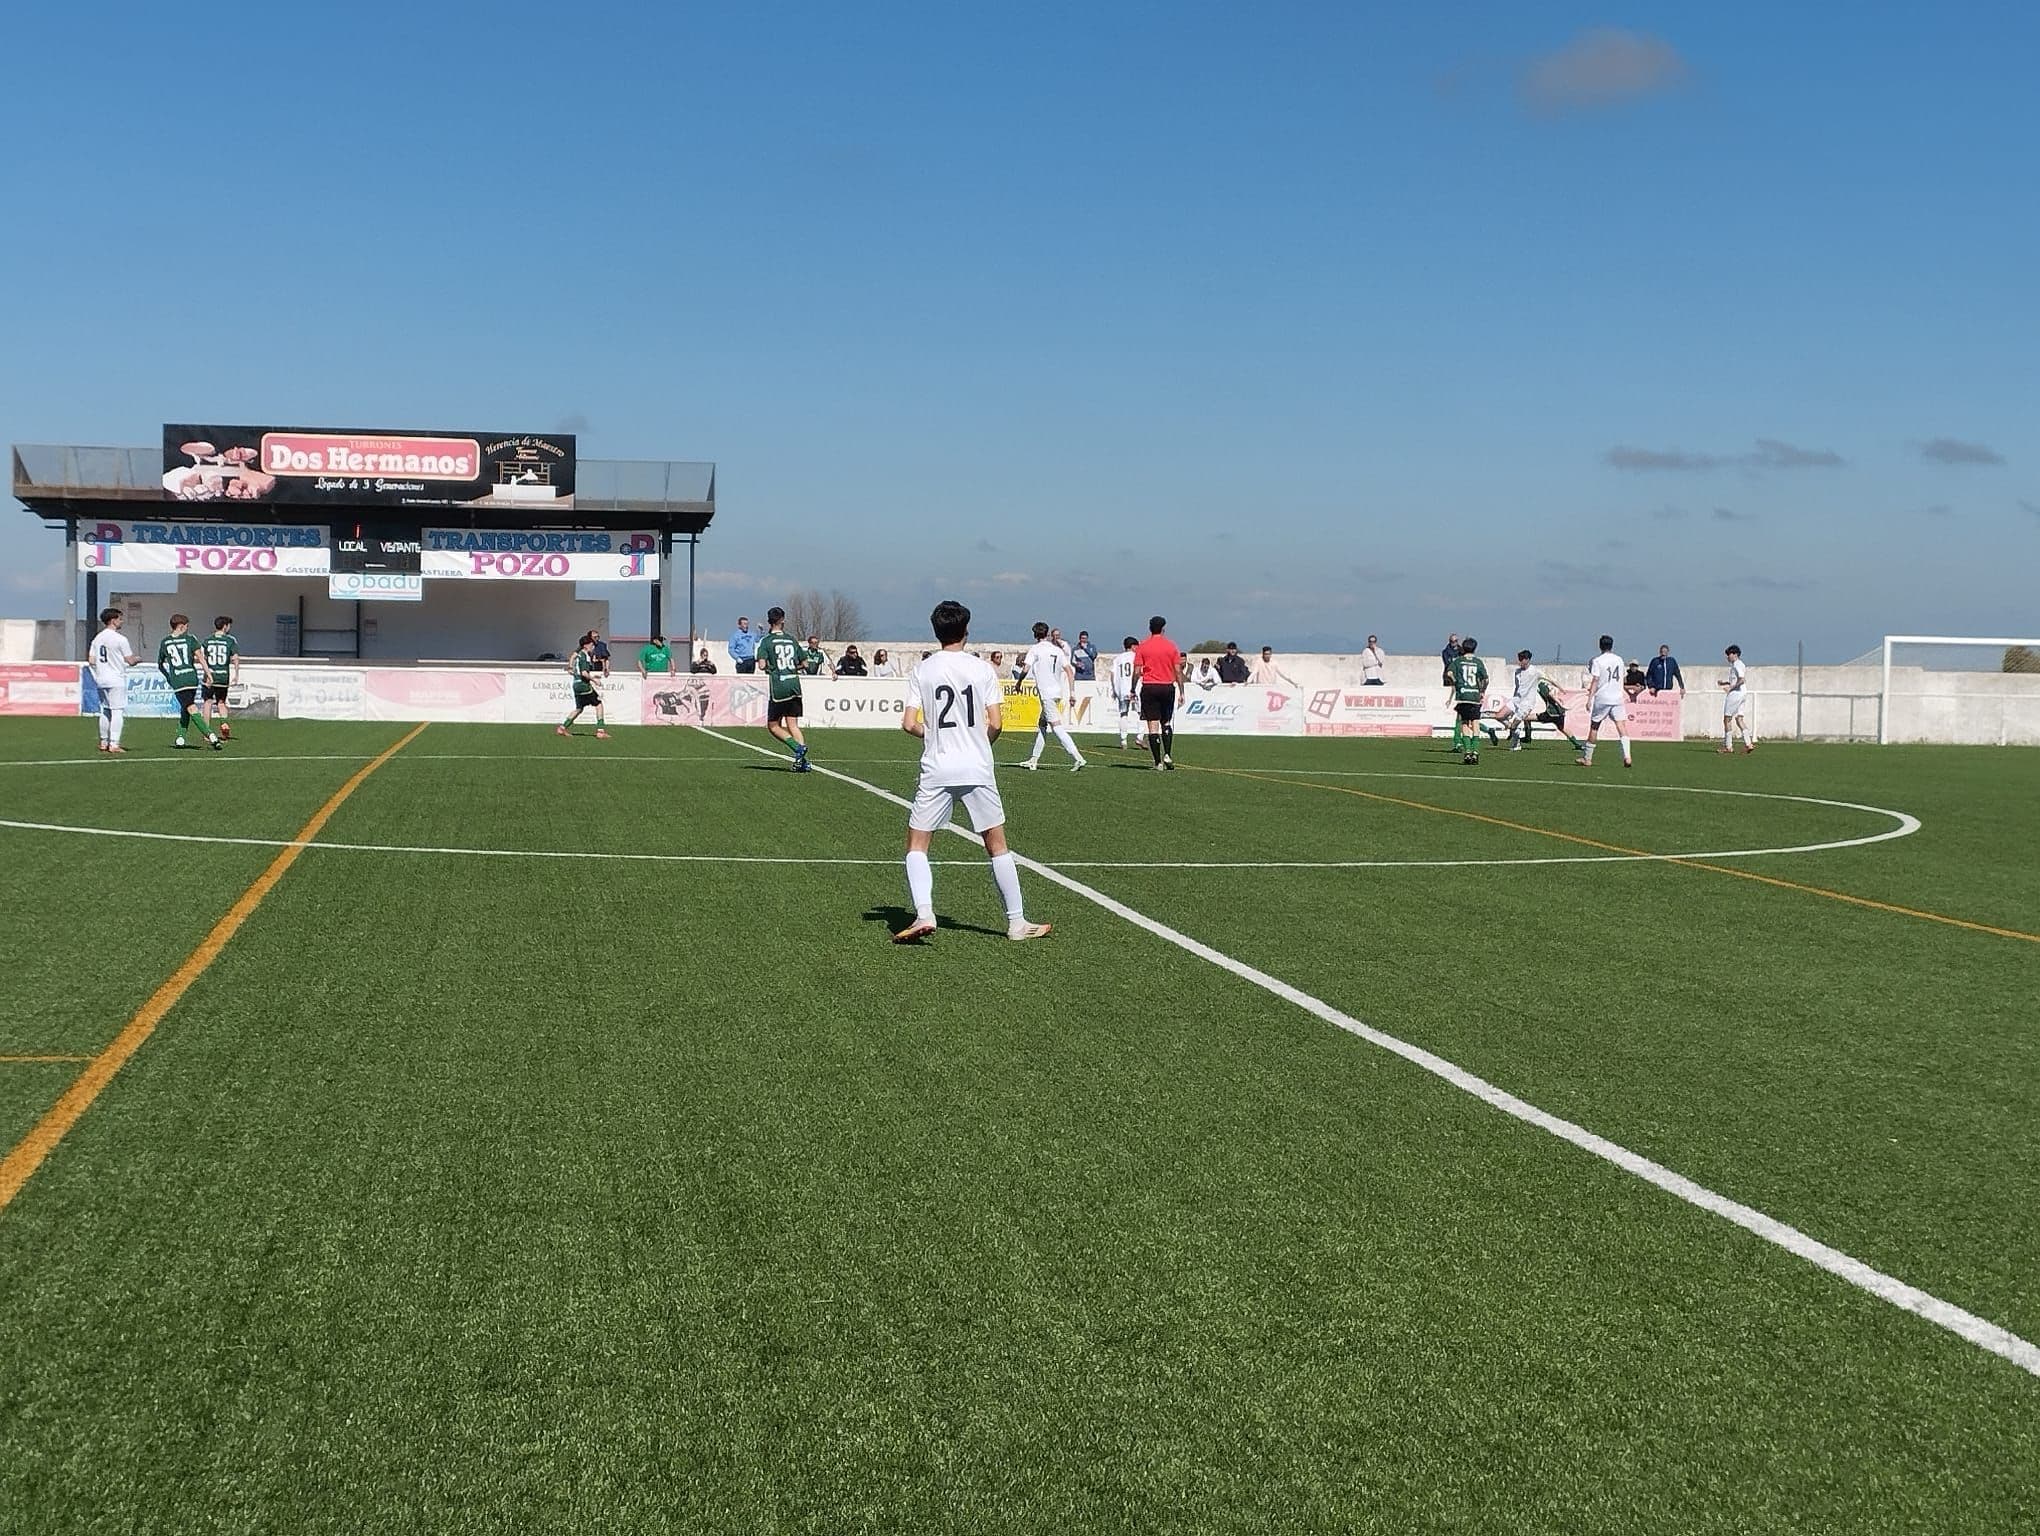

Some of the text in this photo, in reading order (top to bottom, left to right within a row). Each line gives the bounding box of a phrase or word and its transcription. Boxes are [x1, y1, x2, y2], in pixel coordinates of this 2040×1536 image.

[270, 444, 470, 474] Dos Hermanos
[314, 477, 425, 493] Legado de 3 Generaciones
[132, 524, 322, 547] TRANSPORTES
[338, 541, 367, 552] LOCAL
[429, 530, 612, 552] TRANSPORTES
[175, 546, 278, 572] POZO
[469, 551, 570, 577] POZO
[99, 644, 108, 663] 9
[166, 643, 189, 666] 37
[206, 644, 228, 666] 35
[1050, 654, 1058, 674] 7
[1119, 662, 1132, 678] 19
[1462, 664, 1478, 686] 15
[1607, 665, 1620, 682] 14
[1003, 685, 1040, 697] BENITO
[824, 698, 904, 713] covica
[934, 683, 976, 730] 21
